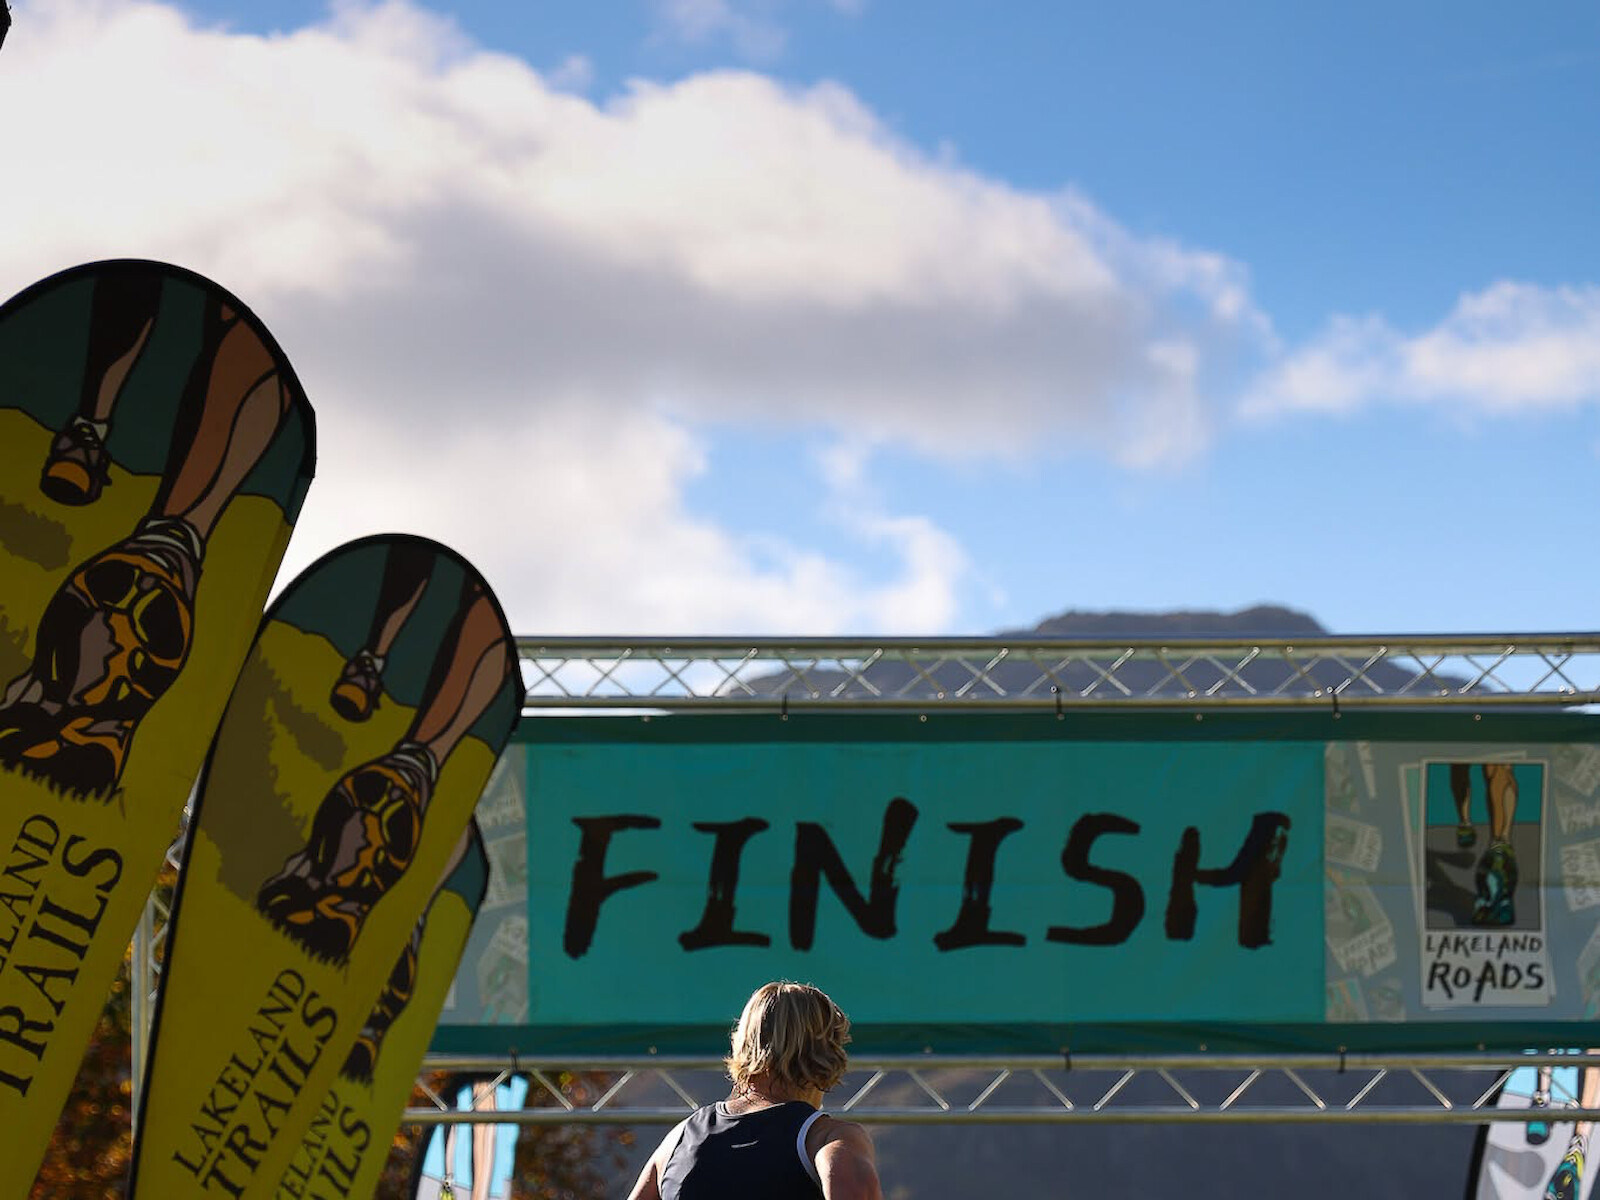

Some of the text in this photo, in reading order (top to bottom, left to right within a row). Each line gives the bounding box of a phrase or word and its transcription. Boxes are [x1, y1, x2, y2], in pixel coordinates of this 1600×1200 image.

[562, 797, 1291, 959] FINISH
[1426, 935, 1543, 959] LAKELAND
[172, 969, 305, 1177] LAKELAND
[201, 991, 338, 1200] TRAILS
